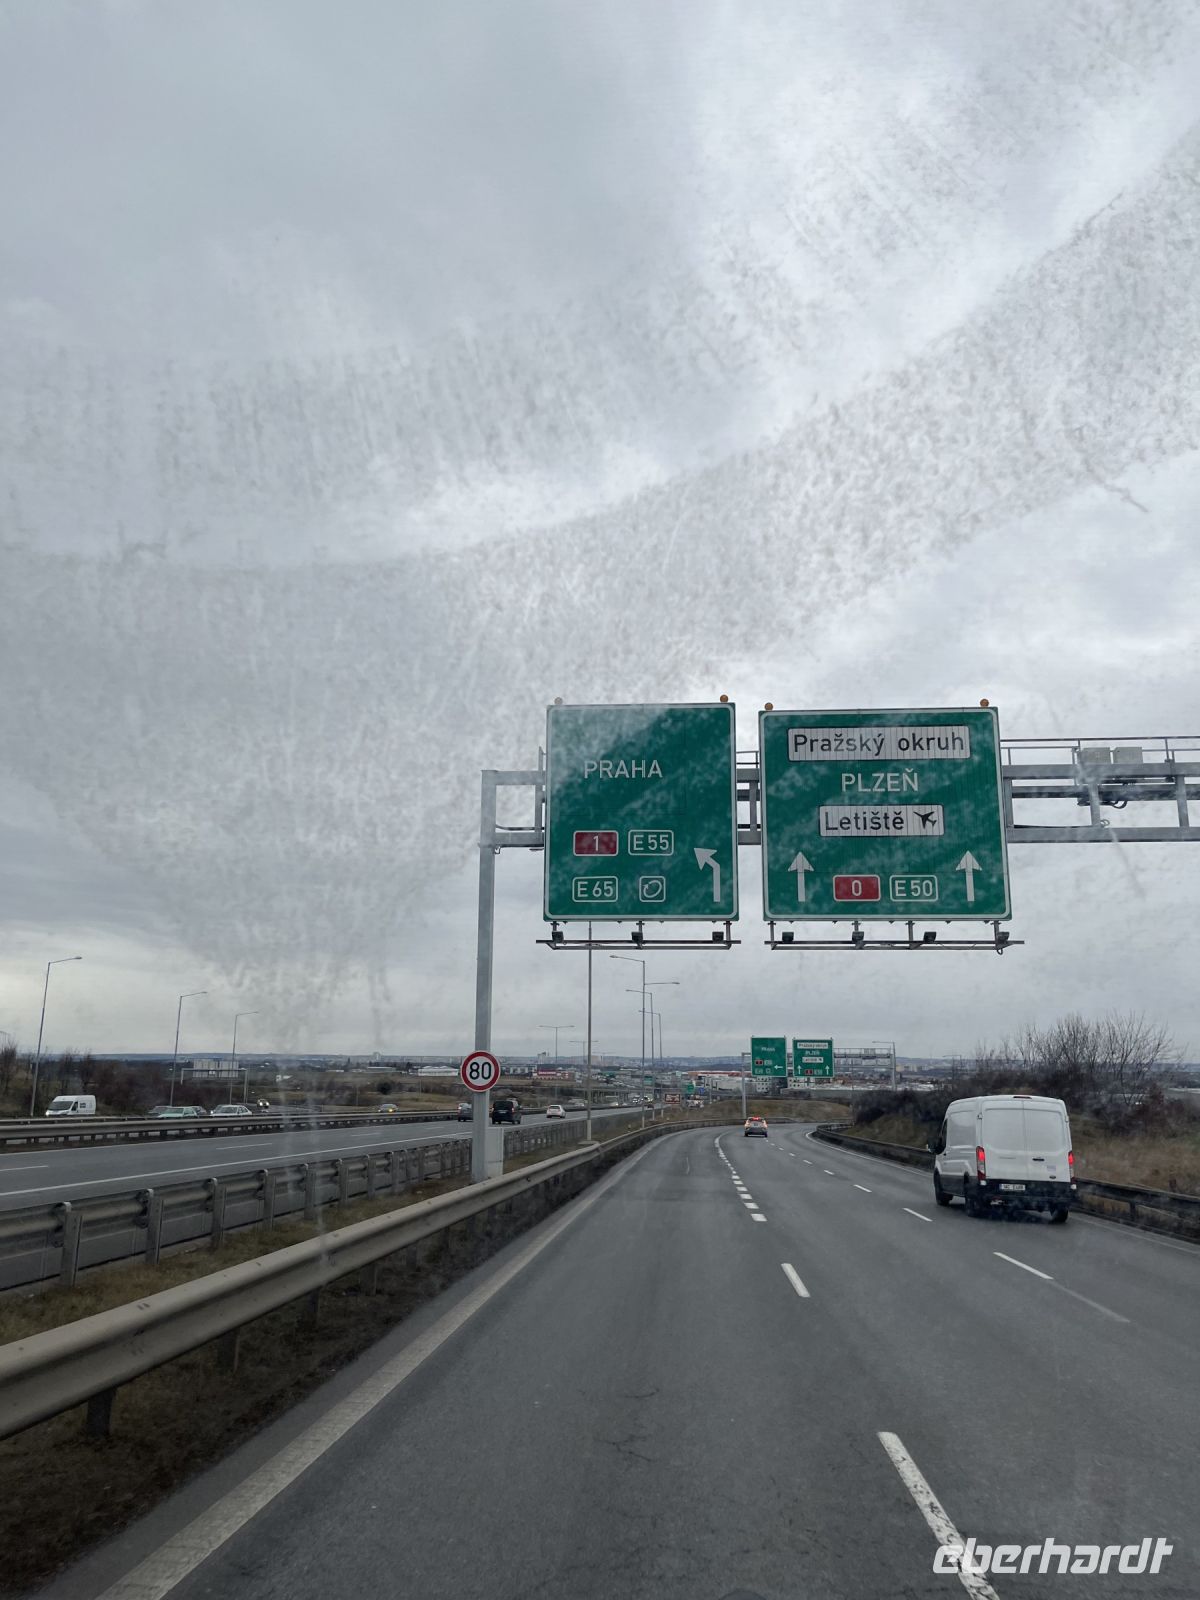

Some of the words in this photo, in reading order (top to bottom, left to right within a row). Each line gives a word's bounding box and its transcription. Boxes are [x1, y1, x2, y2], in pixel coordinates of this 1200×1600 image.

[793, 733, 884, 756] Pražský
[897, 732, 964, 751] okruh
[584, 760, 663, 778] PRAHA
[841, 768, 919, 792] PLZEŇ
[824, 811, 905, 831] Letiště
[593, 835, 600, 852] 1
[851, 879, 863, 897] 0
[469, 1061, 492, 1080] 80
